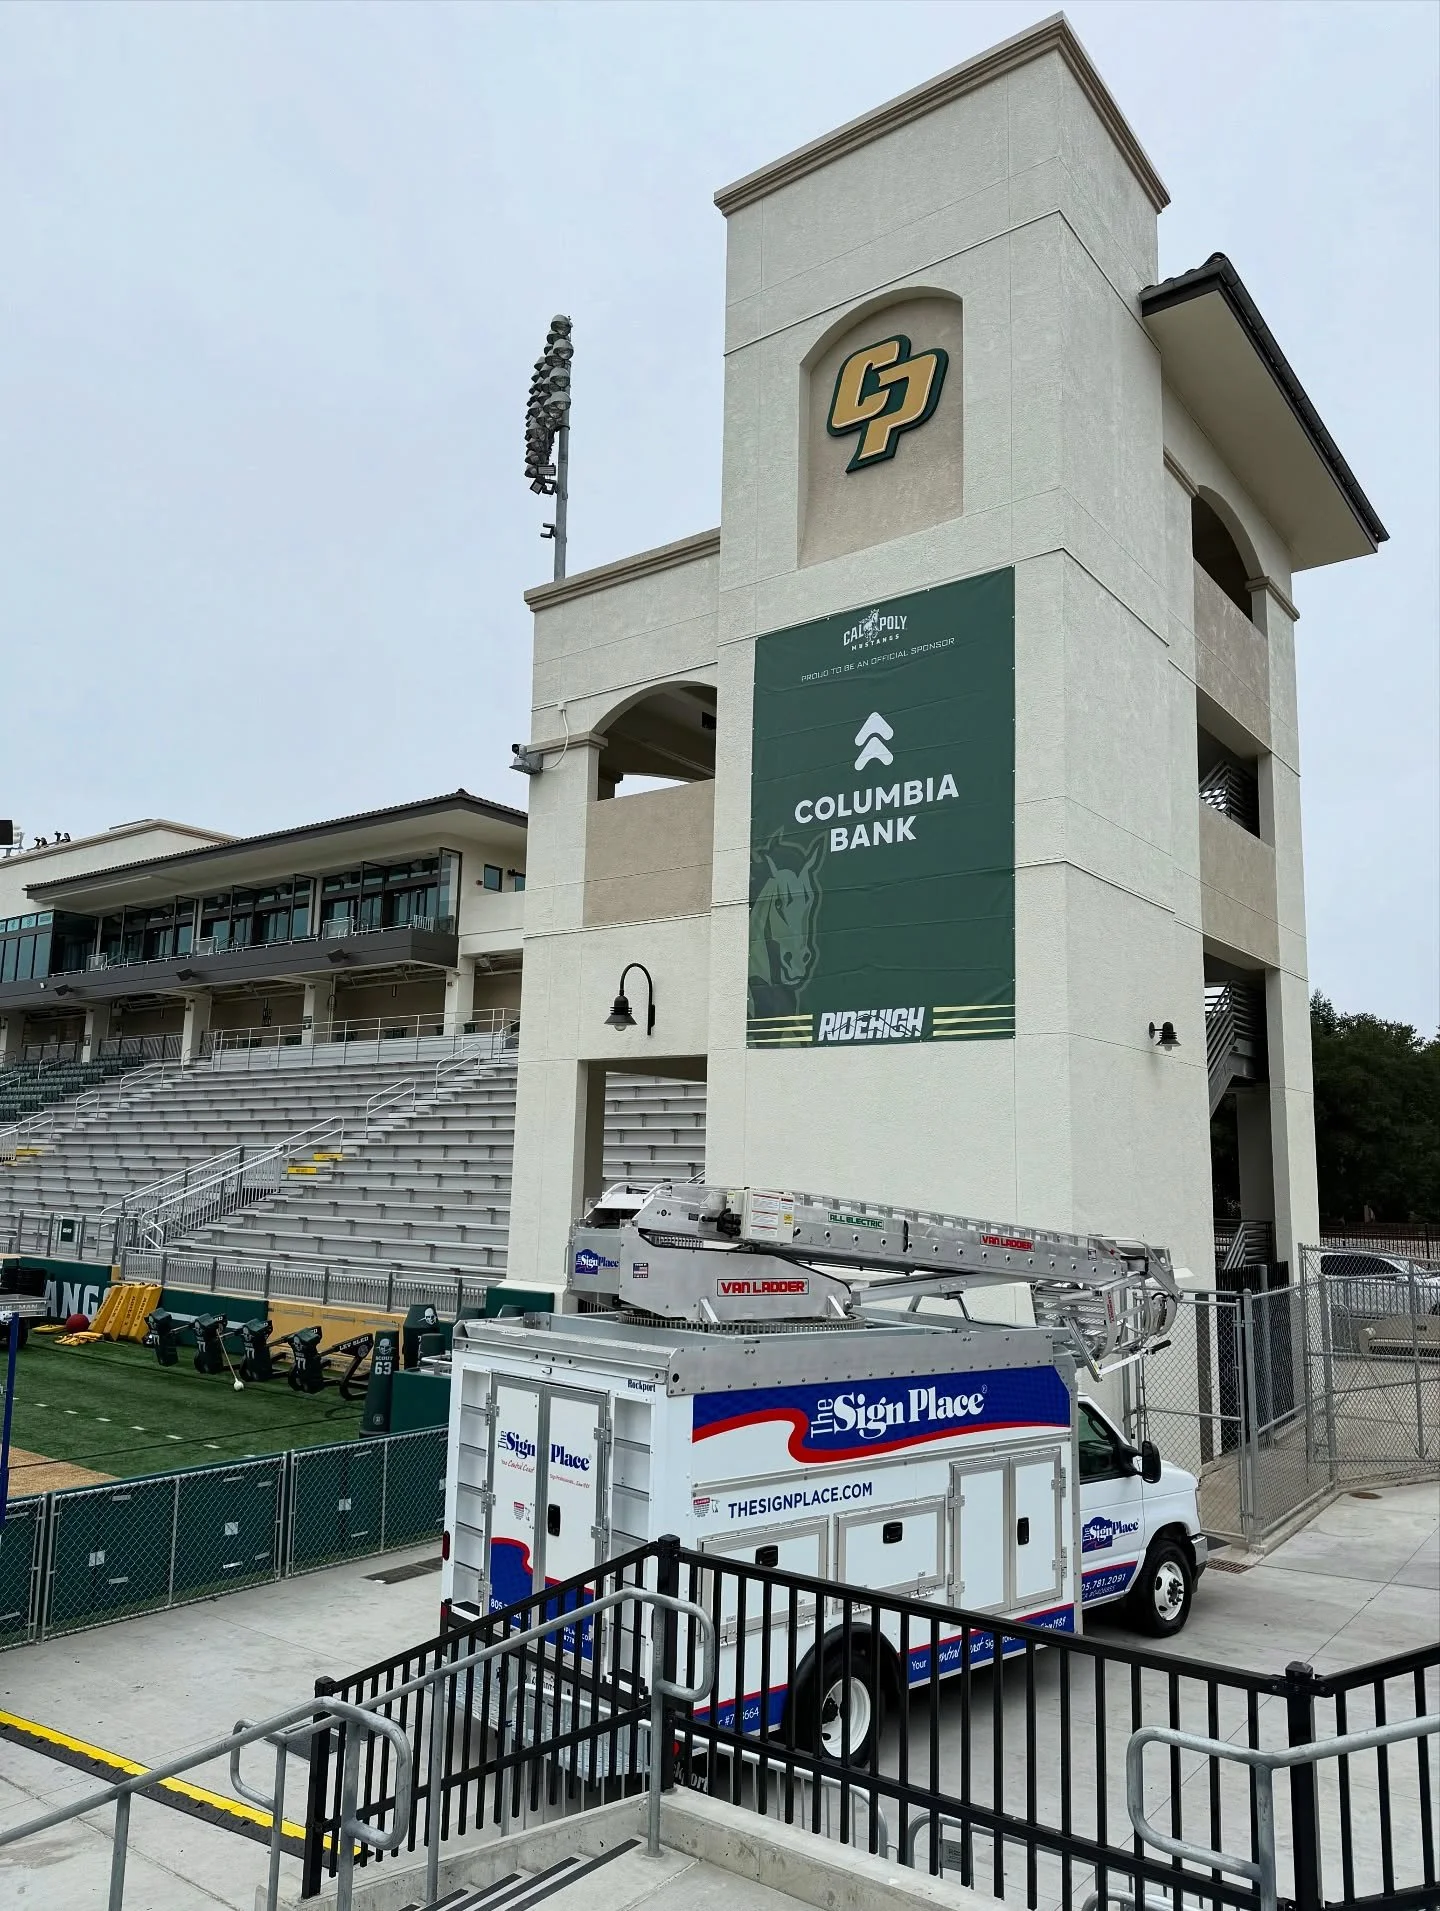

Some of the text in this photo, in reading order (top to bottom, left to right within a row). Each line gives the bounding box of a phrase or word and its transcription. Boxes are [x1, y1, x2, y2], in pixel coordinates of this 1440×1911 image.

[843, 615, 908, 646] CAL POLY
[851, 633, 900, 651] MUSTANGS
[801, 637, 955, 682] PROUD TO BE AN OFFICIAL SPONSOR
[794, 773, 960, 824] COLUMBIA
[830, 815, 917, 853] BANK
[829, 1213, 883, 1228] ALL ELECTRIC
[981, 1235, 1033, 1250] VAN LADDER
[581, 1254, 598, 1268] Sign
[598, 1256, 620, 1268] Place
[721, 1280, 805, 1294] VAN LADDER
[374, 1361, 392, 1375] 63
[627, 1379, 656, 1392] Rockport
[811, 1386, 985, 1440] The Sign Place
[505, 1431, 536, 1460] Sign
[550, 1443, 590, 1472] Place
[727, 1481, 874, 1519] THESIGNPLACE.COM
[1089, 1524, 1112, 1542] Sign
[1111, 1520, 1139, 1535] Place
[1081, 1573, 1127, 1592] 05.781.2091
[911, 1659, 927, 1670] Your
